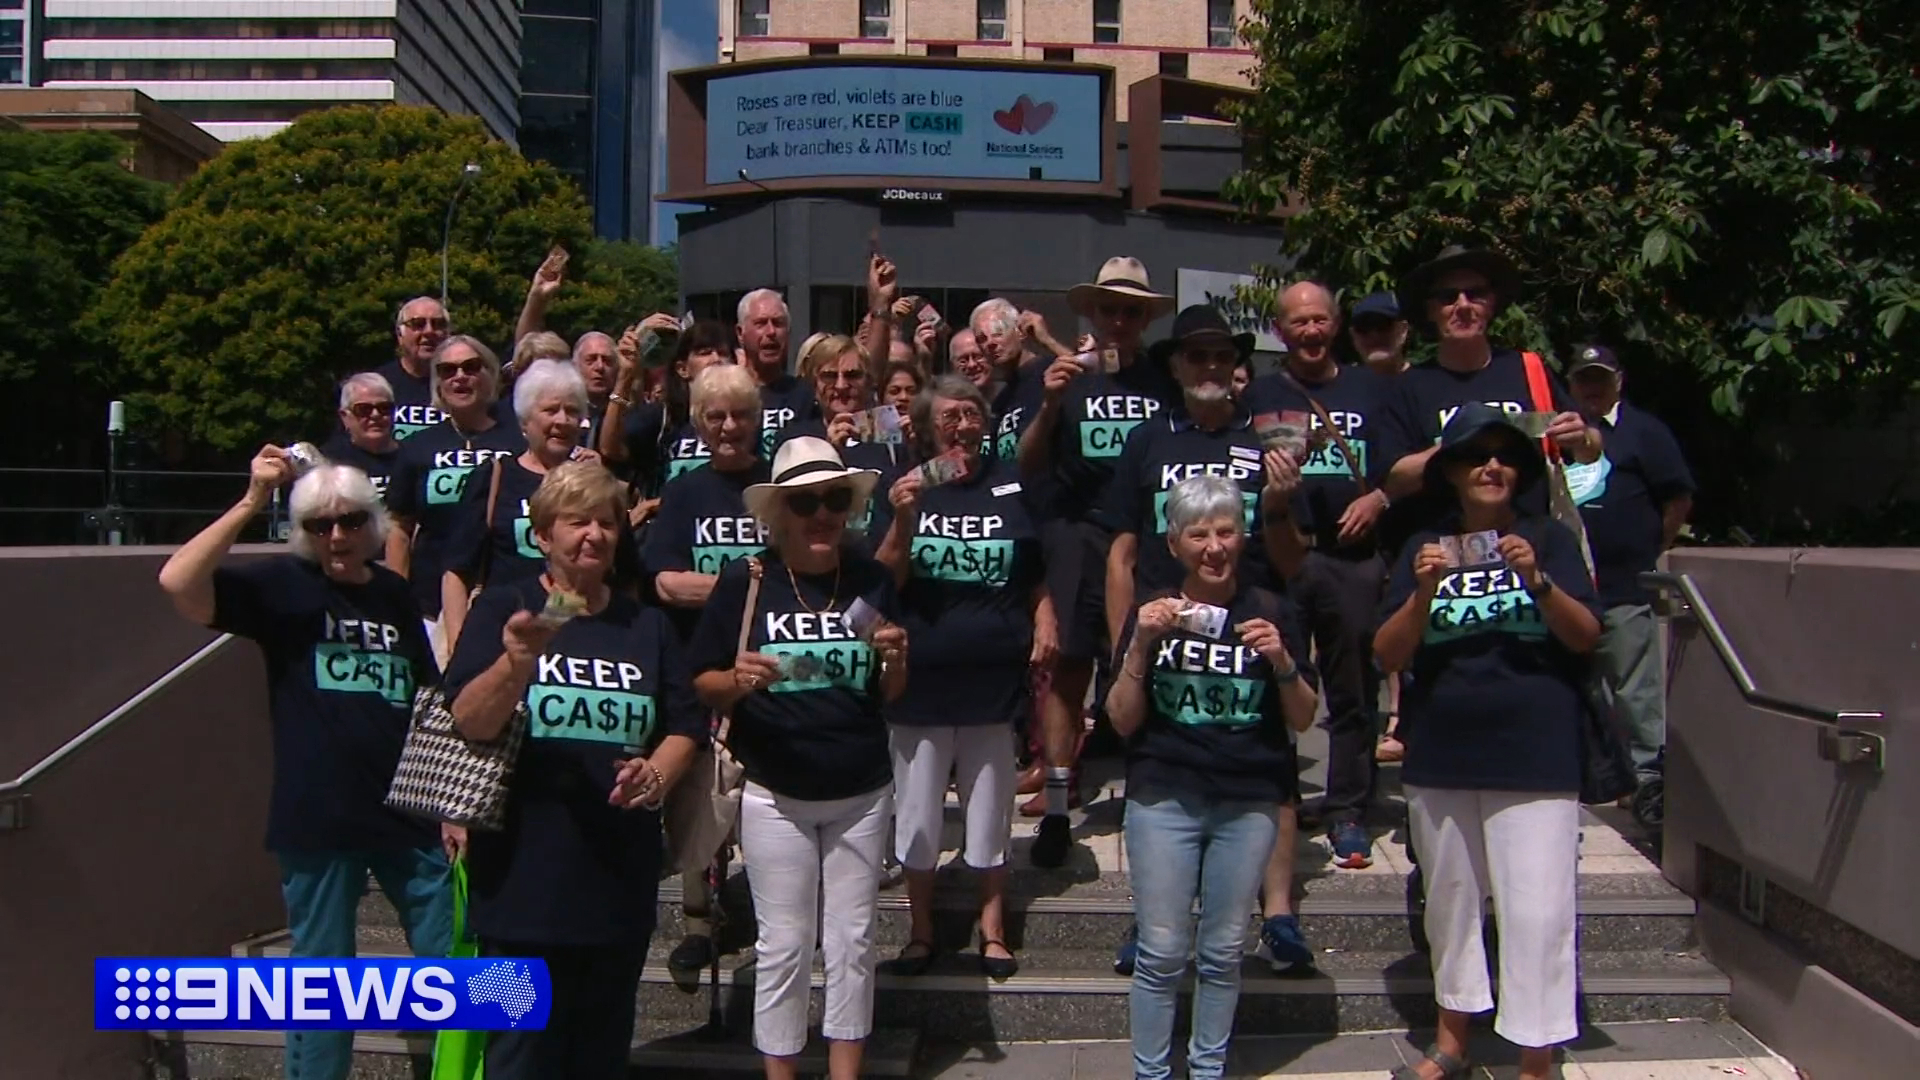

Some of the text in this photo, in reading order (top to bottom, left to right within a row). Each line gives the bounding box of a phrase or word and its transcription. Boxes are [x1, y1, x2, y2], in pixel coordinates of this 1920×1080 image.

[737, 88, 963, 112] Roses are red, violets are blue
[737, 120, 768, 136] Dear
[774, 115, 848, 132] Treasurer,
[852, 113, 900, 129] KEEP
[747, 138, 951, 160] bank branches & ATMs too!
[986, 142, 1064, 155] National Seniors
[882, 188, 943, 201] JCDecaux
[762, 407, 795, 429] EP
[1085, 395, 1161, 420] KEEP
[918, 511, 1004, 539] KEEP
[917, 544, 1005, 573] CA$H
[766, 611, 857, 642] KEE
[537, 653, 645, 691] KEEP
[1157, 681, 1255, 719] CA$H
[538, 694, 650, 733] CA$H
